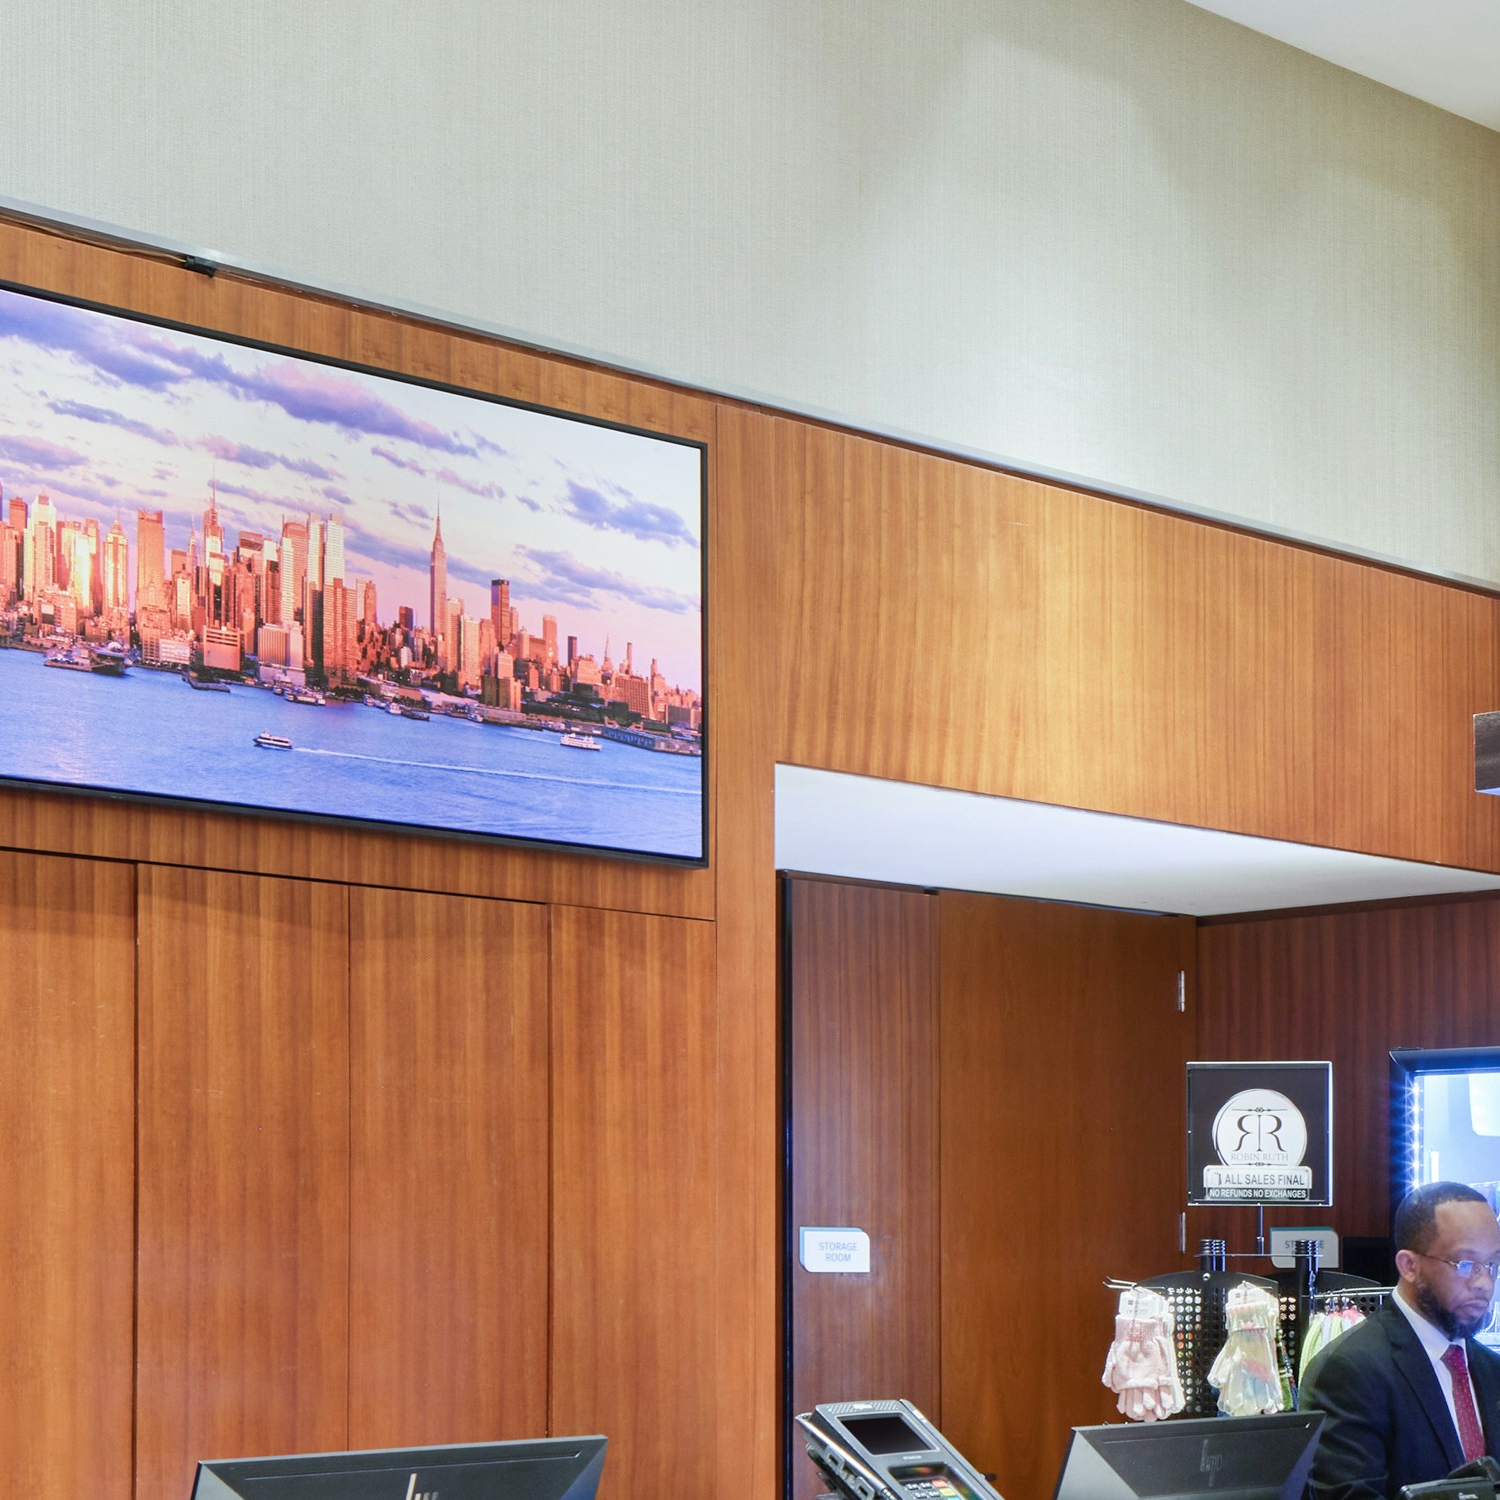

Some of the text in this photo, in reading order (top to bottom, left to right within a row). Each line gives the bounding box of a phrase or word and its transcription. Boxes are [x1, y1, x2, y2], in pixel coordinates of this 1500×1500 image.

[1230, 1152, 1289, 1162] ROBIN RUTH
[1224, 1174, 1305, 1186] ALL SALES FINAL
[1209, 1189, 1307, 1199] NO REFUNDS NO EXCHANGES
[819, 1242, 857, 1251] STORAGE
[1285, 1241, 1325, 1249] STGE
[825, 1253, 852, 1262] ROOM
